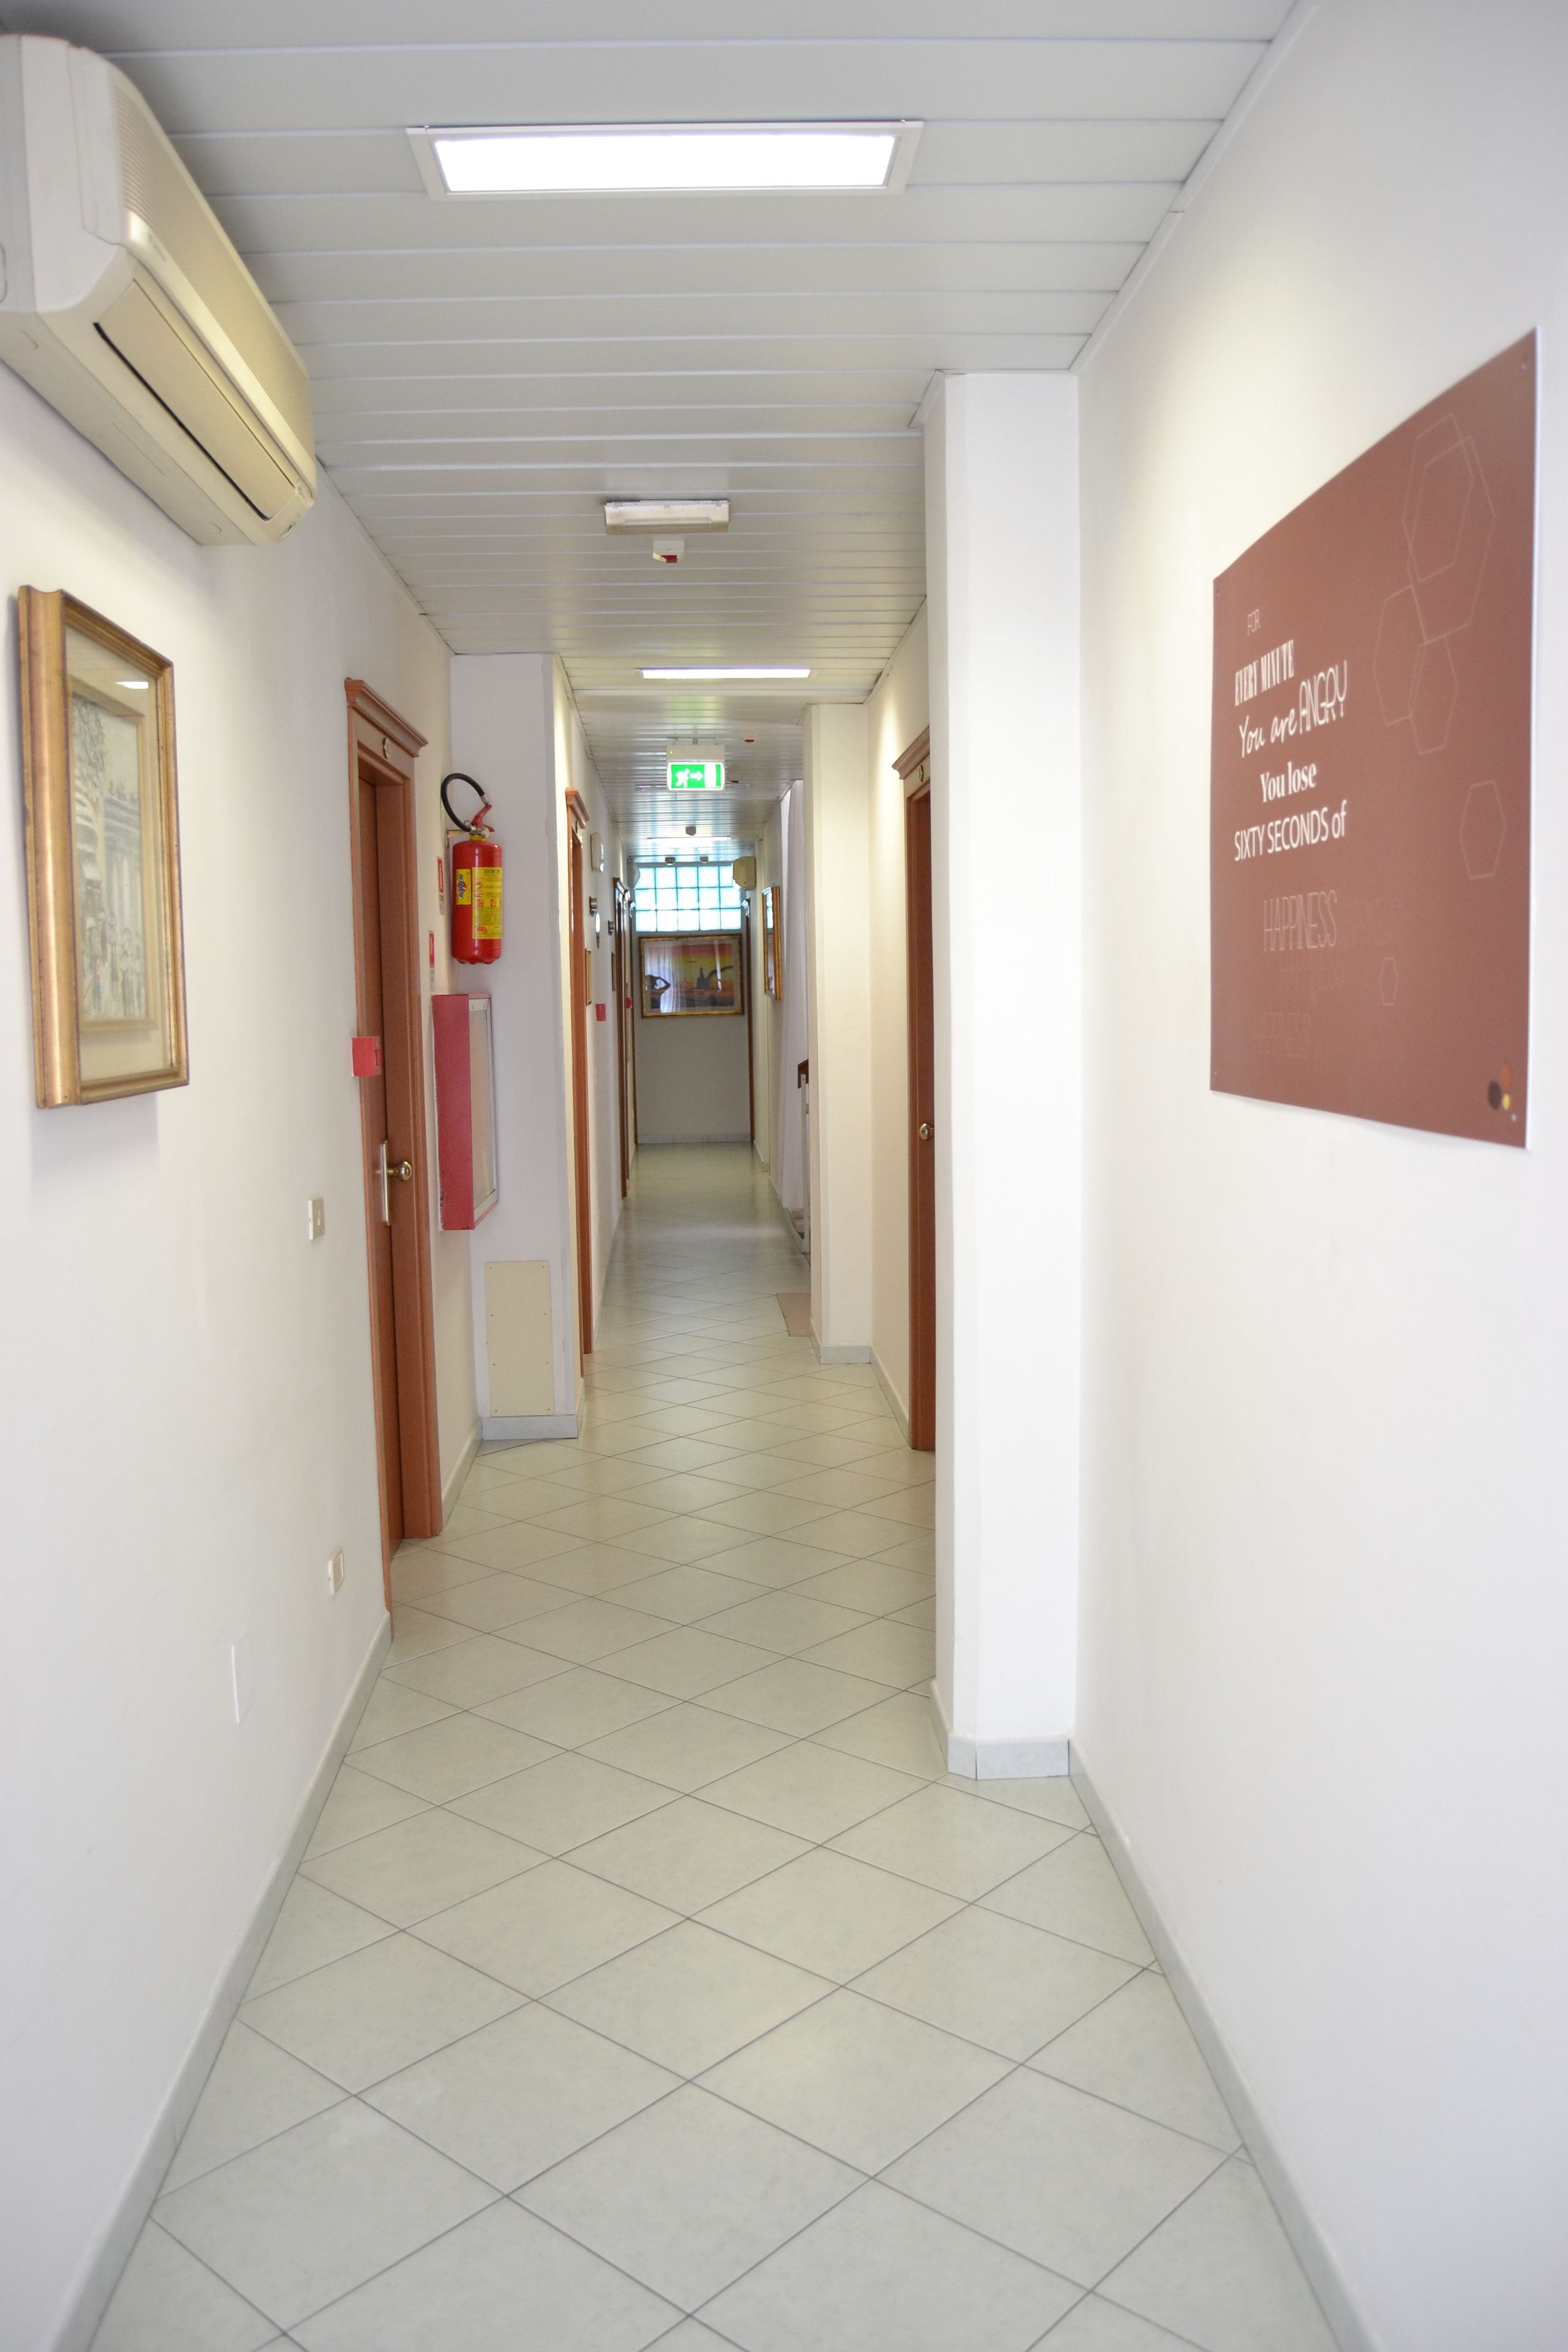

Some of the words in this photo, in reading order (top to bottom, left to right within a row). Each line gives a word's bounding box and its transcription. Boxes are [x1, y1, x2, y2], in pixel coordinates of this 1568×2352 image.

[1247, 609, 1261, 635] FOR
[1235, 660, 1258, 707] EVERY
[1261, 639, 1294, 693] MINUTE
[1238, 715, 1265, 758] You
[1270, 708, 1298, 744] are
[1298, 660, 1348, 735] ANGRY
[1259, 772, 1286, 803] You
[1287, 761, 1317, 795] lose
[1234, 824, 1265, 861] SIXTY
[1267, 806, 1329, 854] SECONDS
[1331, 799, 1348, 839] of
[1263, 889, 1338, 952] HAPPINESS
